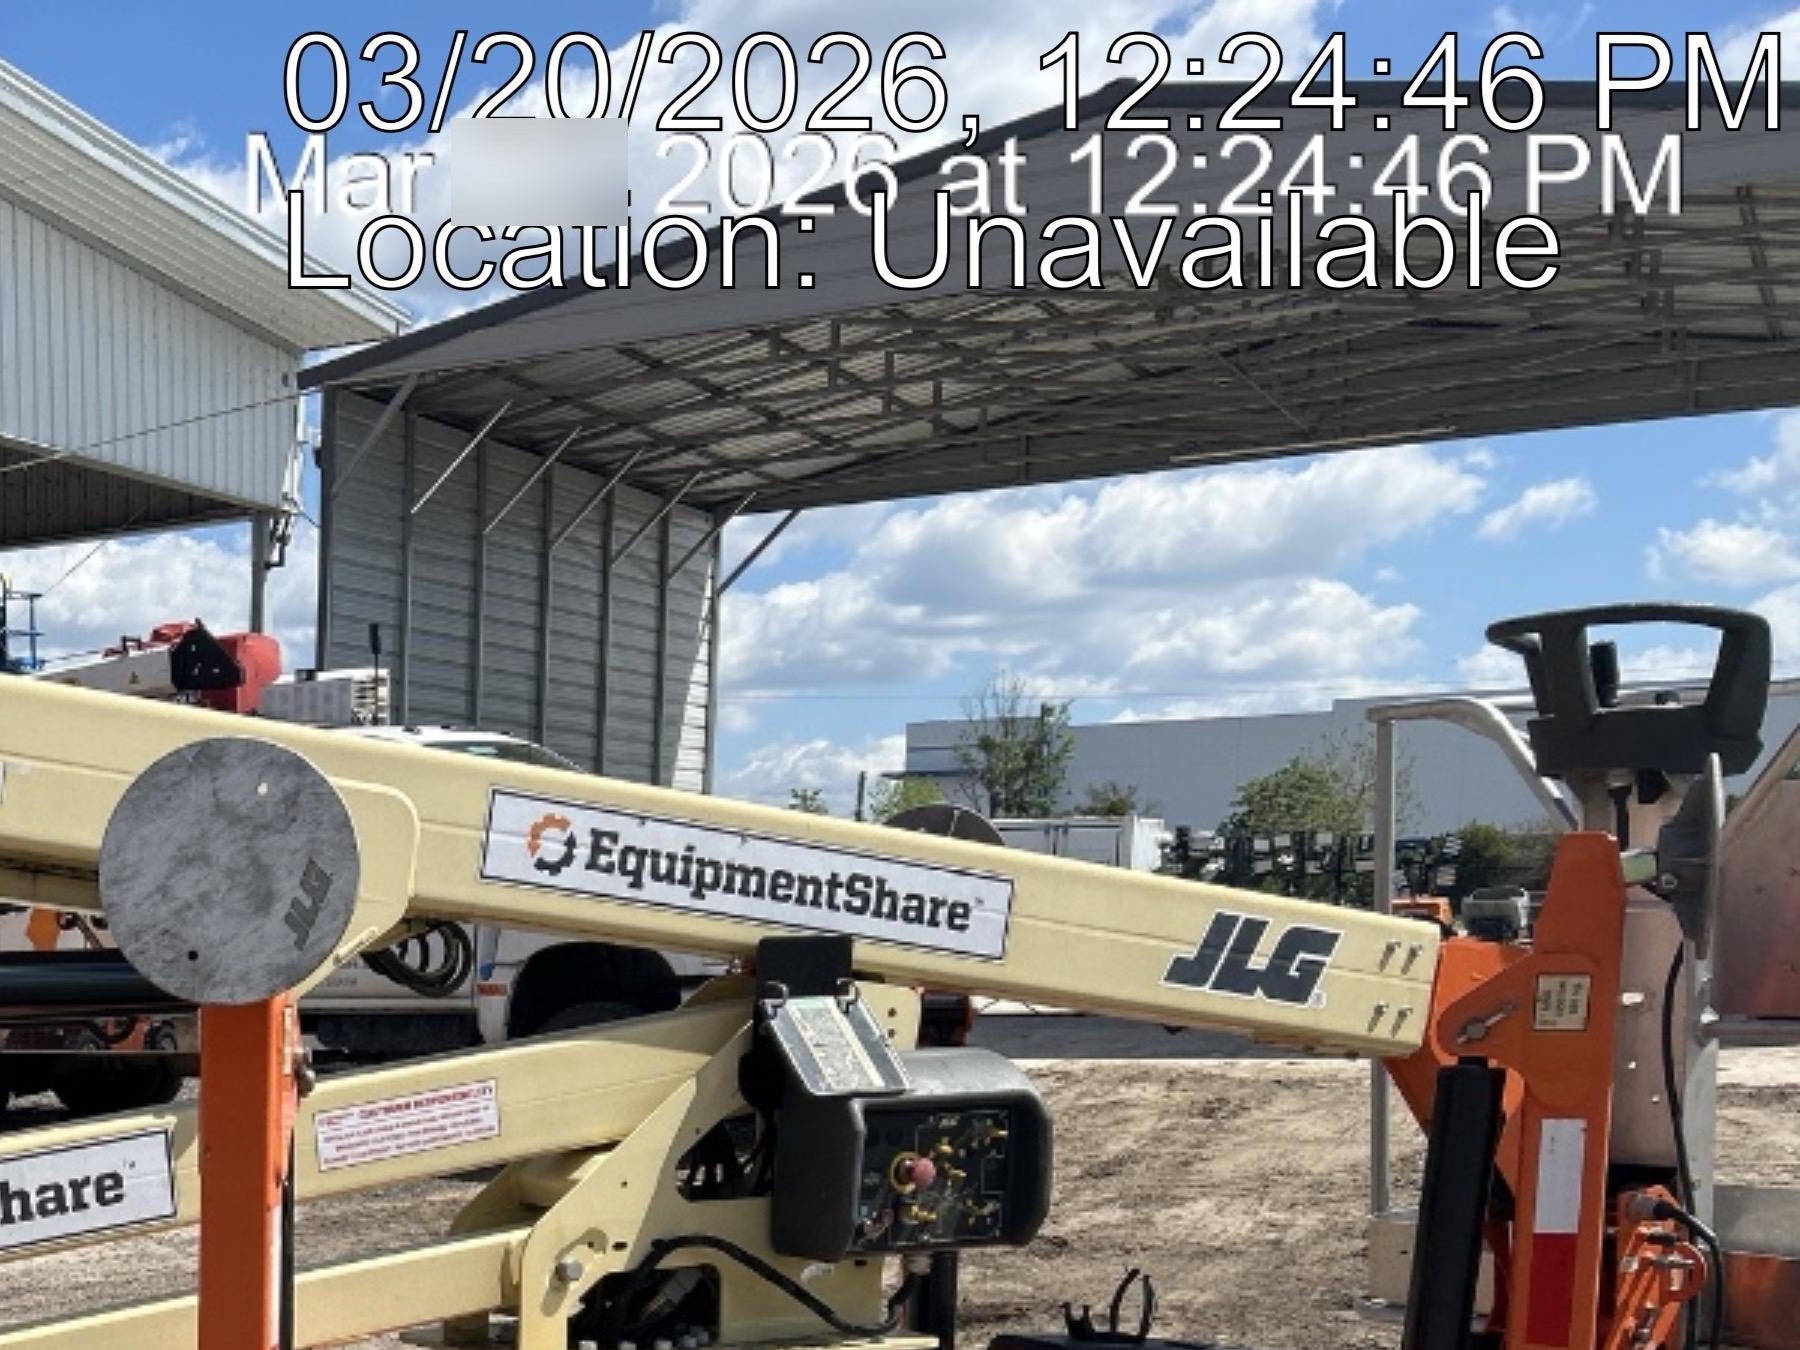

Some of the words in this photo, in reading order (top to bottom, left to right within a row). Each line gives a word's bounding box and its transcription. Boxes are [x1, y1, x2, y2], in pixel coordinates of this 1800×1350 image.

[283, 855, 334, 952] JLG
[584, 827, 972, 933] EquipmentShare
[1161, 908, 1345, 1007] JLG
